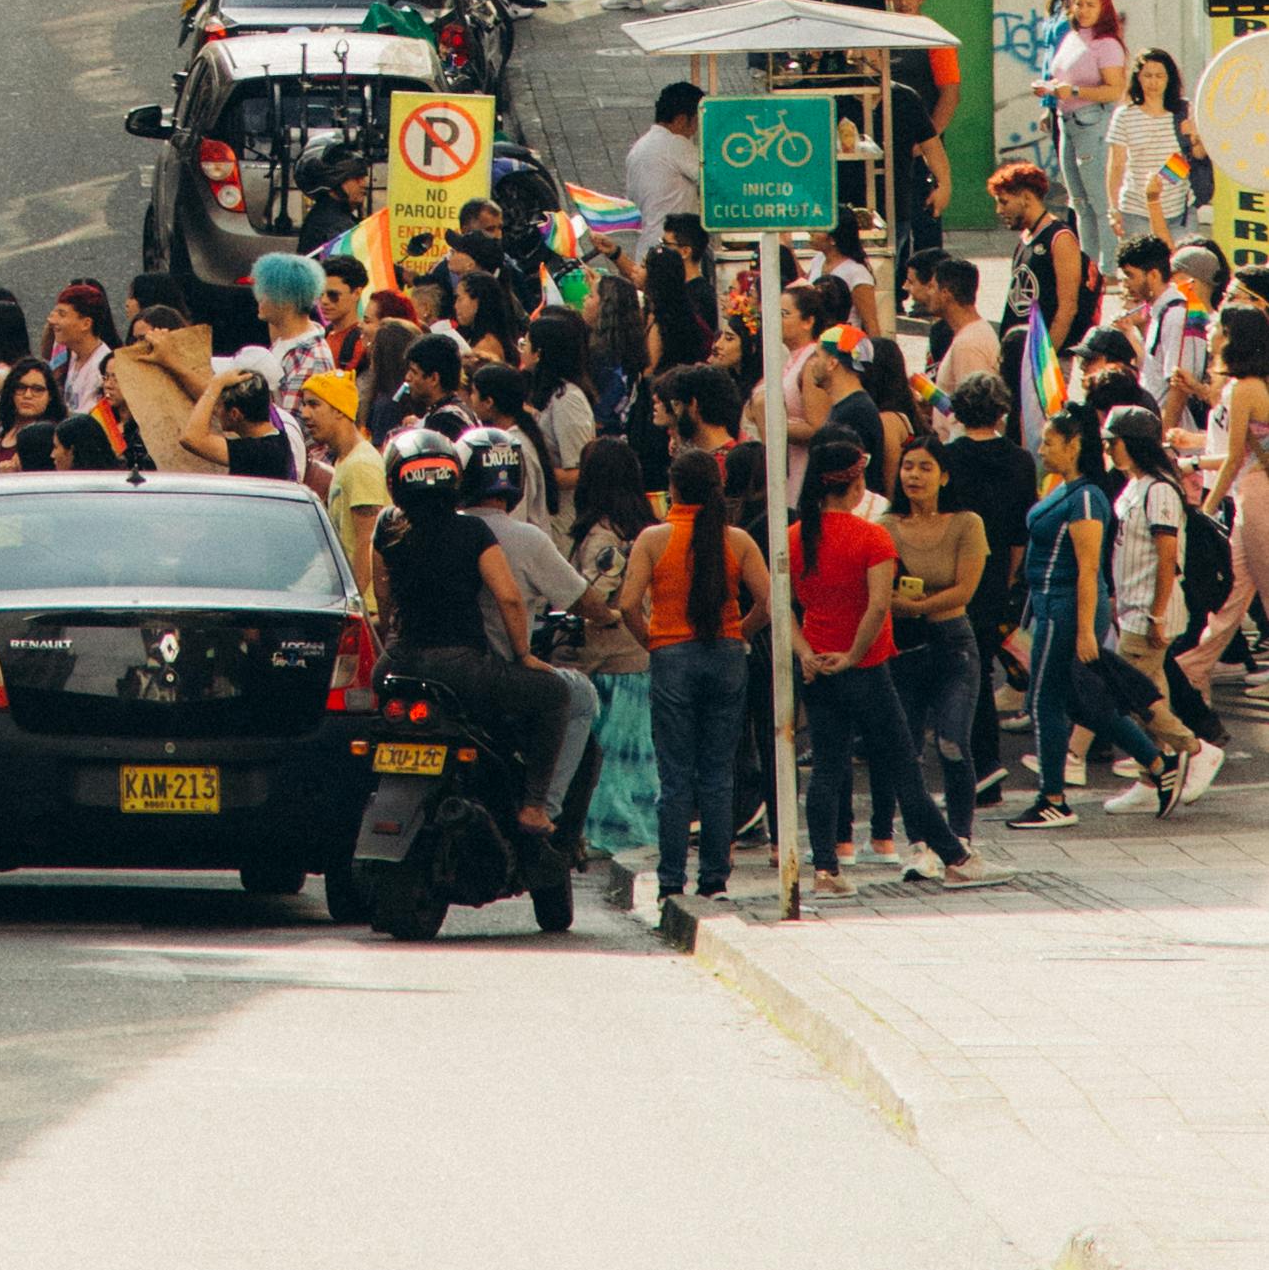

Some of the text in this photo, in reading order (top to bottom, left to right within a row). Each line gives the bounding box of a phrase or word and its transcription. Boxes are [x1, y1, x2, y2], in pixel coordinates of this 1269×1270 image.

[426, 188, 448, 203] NO
[742, 182, 794, 197] INICIO
[394, 204, 459, 220] PARQUE
[713, 203, 824, 219] CICLORRUTA
[9, 639, 73, 649] RENAULT
[125, 772, 216, 800] KAM-213
